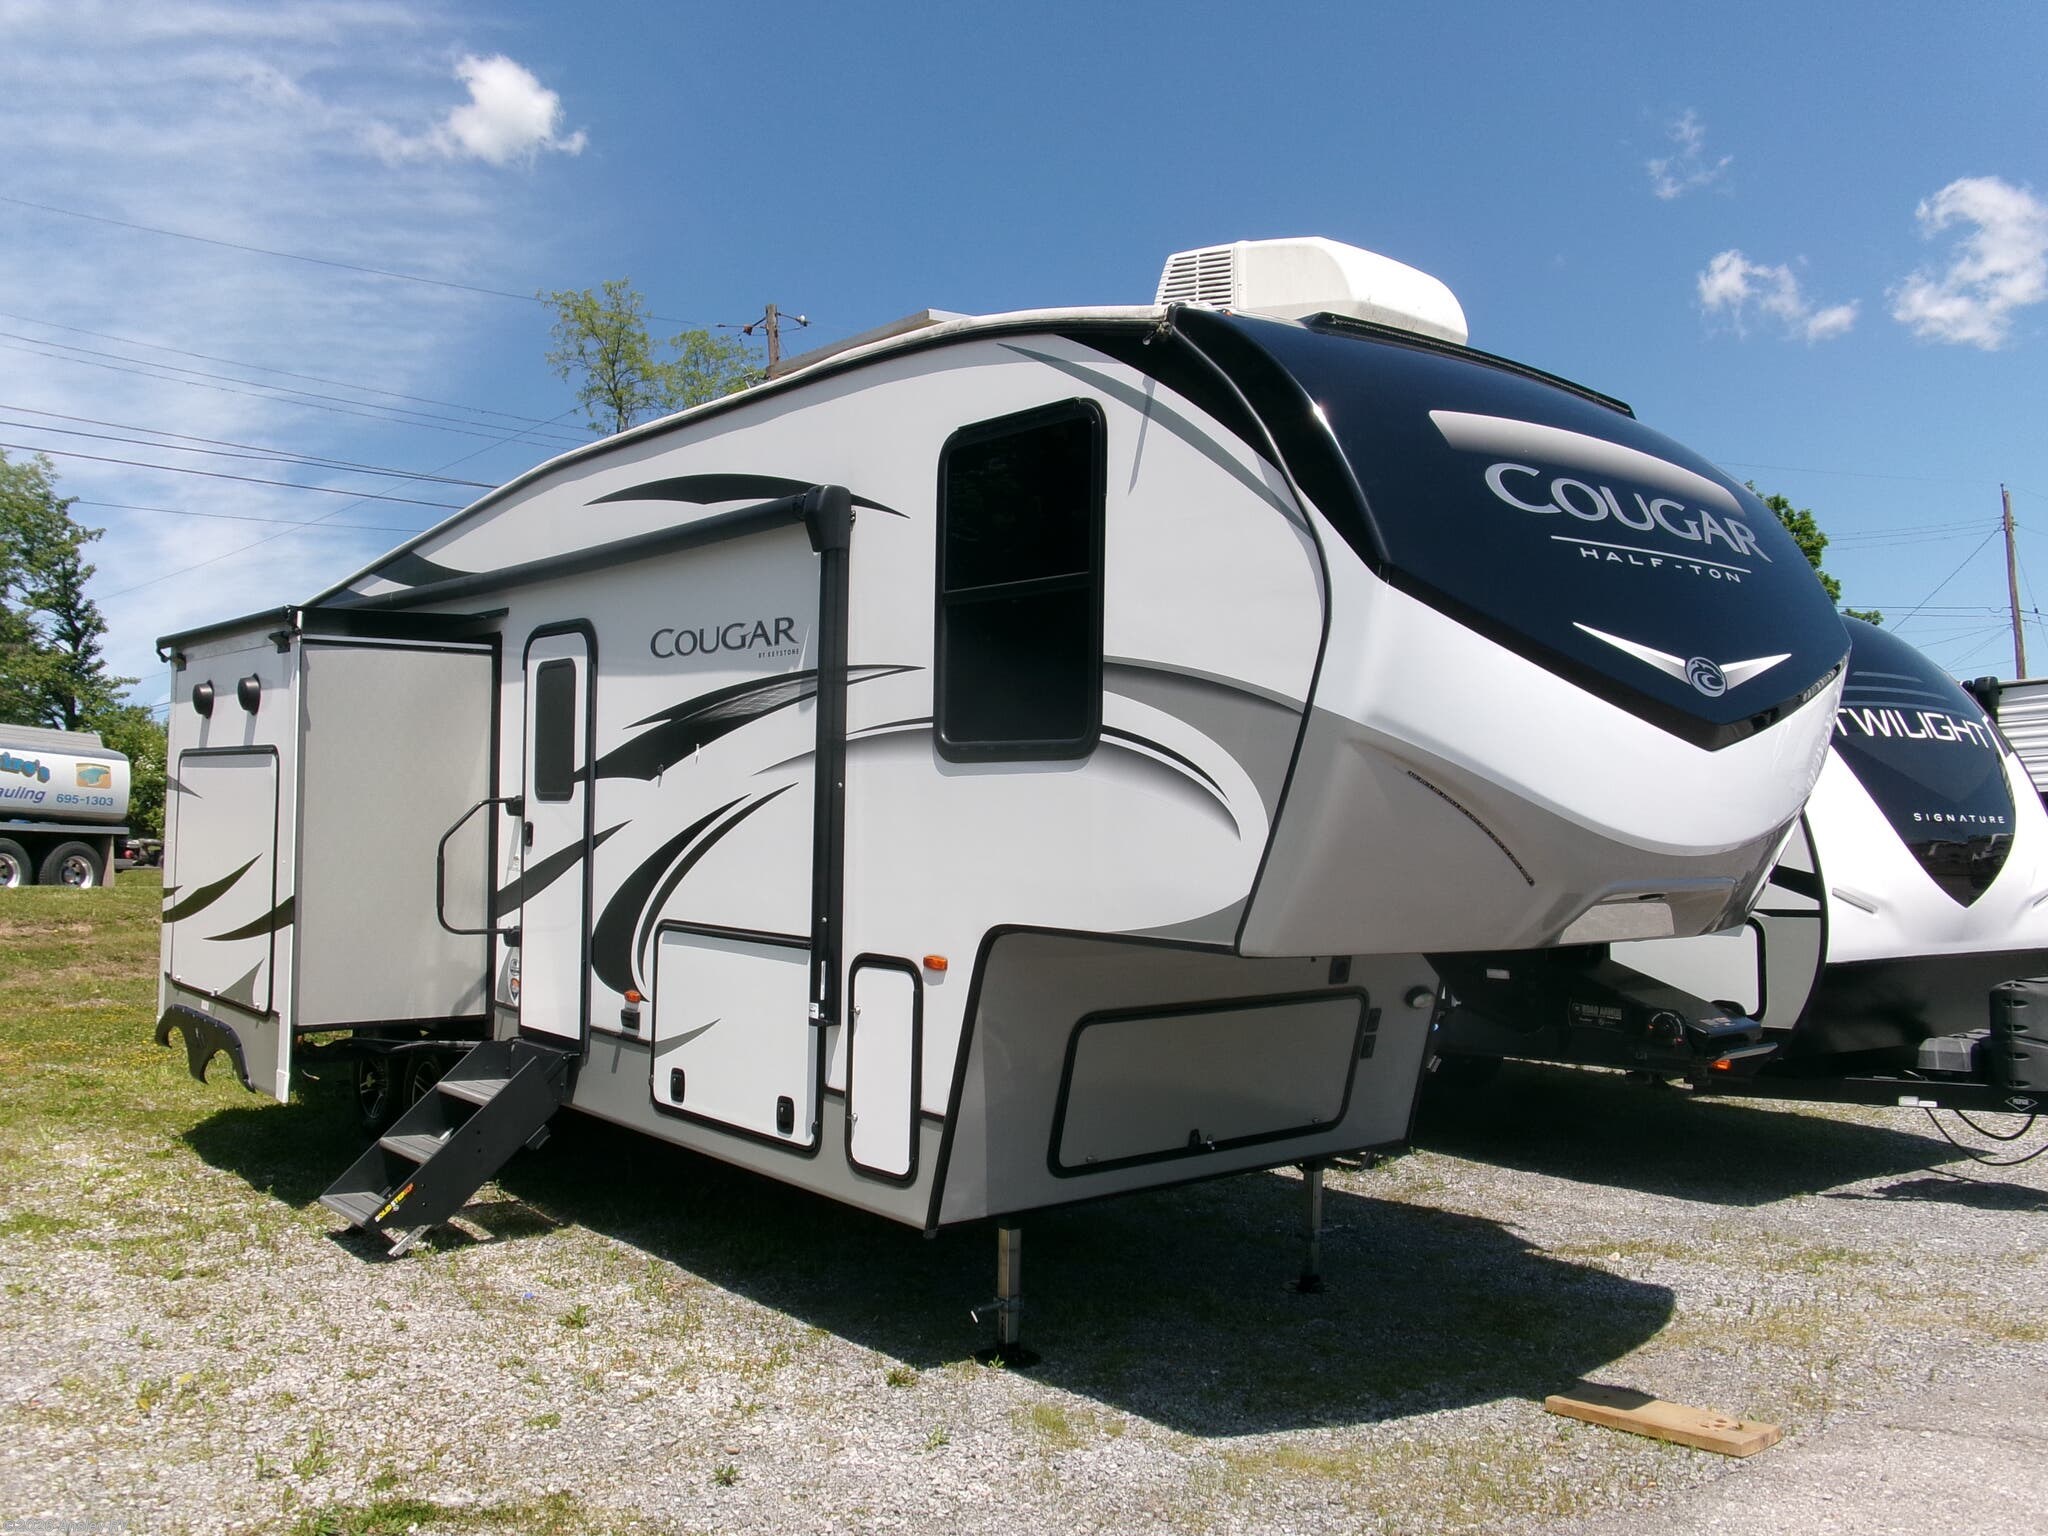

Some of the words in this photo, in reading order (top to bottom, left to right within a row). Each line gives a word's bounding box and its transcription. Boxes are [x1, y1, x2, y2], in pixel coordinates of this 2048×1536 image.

[1484, 462, 1772, 564] COUGAR
[1578, 546, 1742, 584] HALF-TON
[650, 616, 800, 659] COUGAR
[1836, 707, 1989, 749] TWILIGHT
[56, 793, 114, 807] 695-1303
[1913, 812, 2006, 825] SIGNATURE
